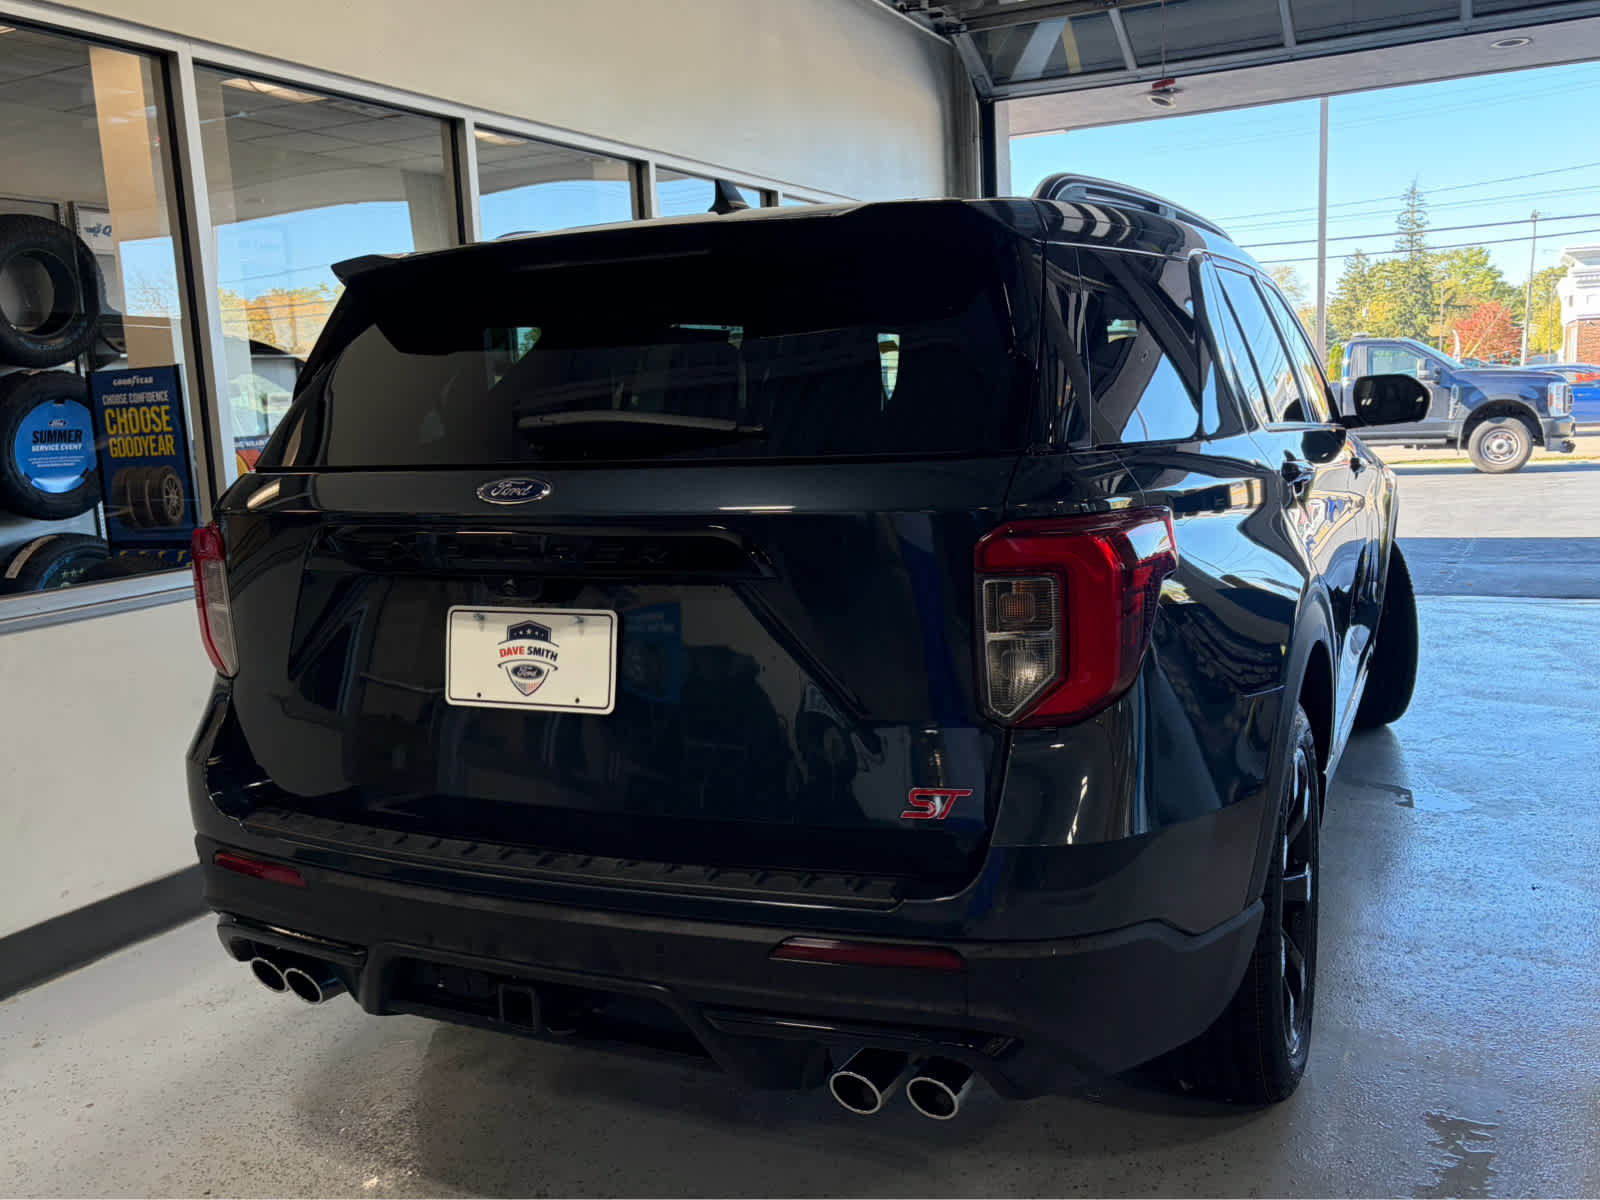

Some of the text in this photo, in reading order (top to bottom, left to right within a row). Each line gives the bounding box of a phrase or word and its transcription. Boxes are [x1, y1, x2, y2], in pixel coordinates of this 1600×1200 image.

[102, 393, 129, 406] CHOOSE
[104, 405, 174, 435] CHOOSE
[32, 429, 82, 444] SUMMER
[32, 443, 82, 453] SERVICE EVENT
[108, 434, 176, 458] GOODYEAR
[490, 480, 534, 497] Ford
[499, 645, 558, 661] DAVE SMITH
[900, 787, 973, 820] ST
